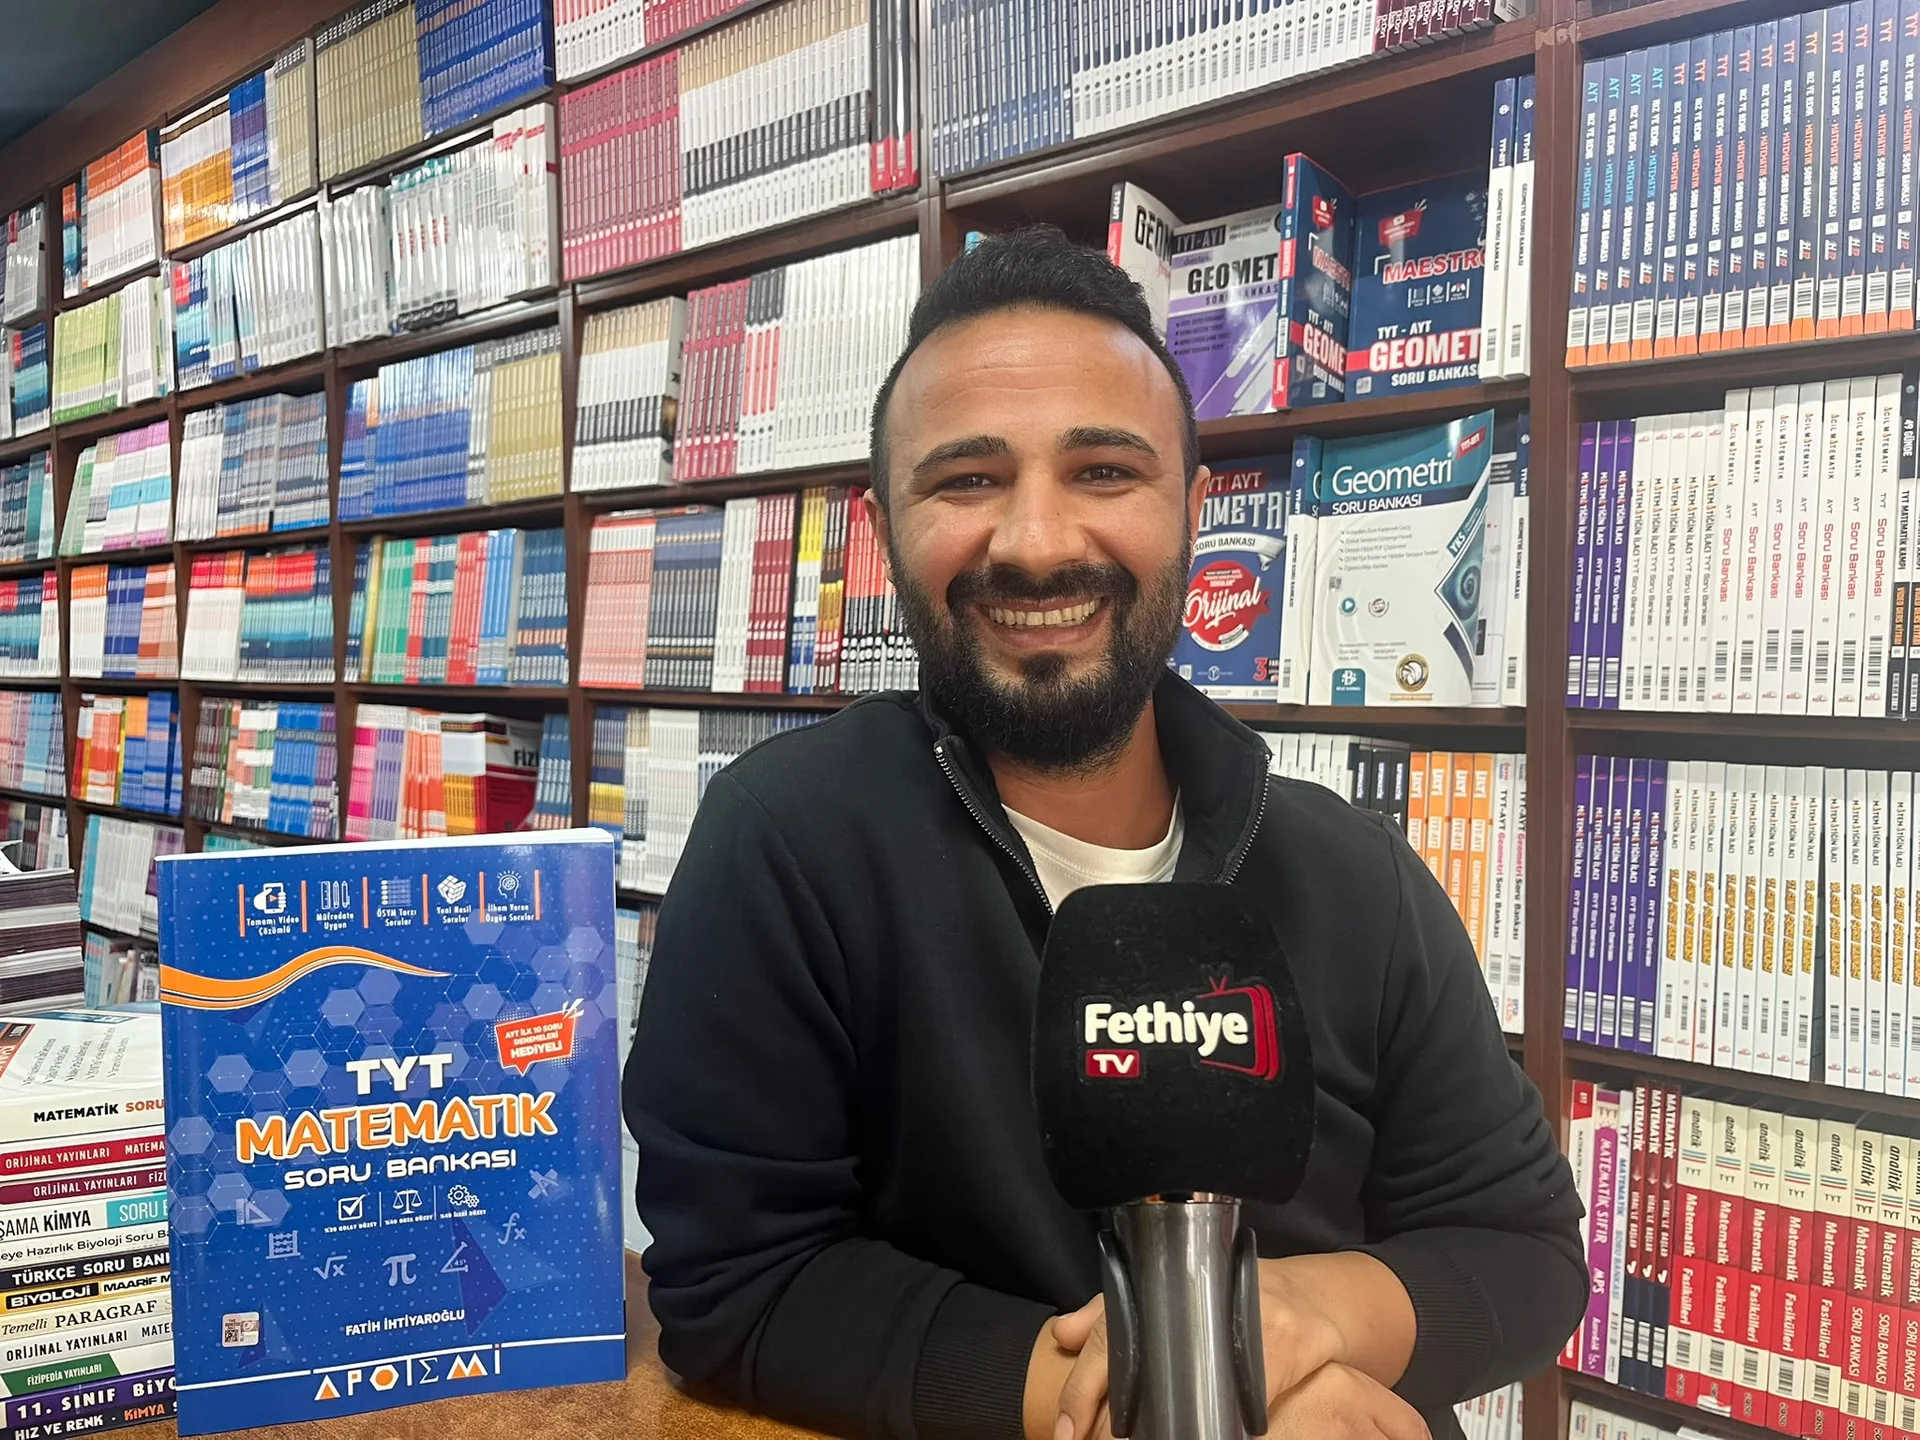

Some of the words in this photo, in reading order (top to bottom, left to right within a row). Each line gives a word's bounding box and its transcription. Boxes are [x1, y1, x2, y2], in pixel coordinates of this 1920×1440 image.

[1856, 24, 1868, 47] TYT
[1905, 12, 1919, 37] TYT
[1806, 32, 1818, 55] TYT
[1717, 55, 1728, 77] TYT
[1761, 45, 1772, 67] TYT
[1653, 68, 1663, 89] AYT
[1588, 82, 1598, 103] AYT
[1378, 325, 1398, 340] TYT
[1410, 320, 1432, 335] AYT
[1391, 371, 1425, 386] SORU
[1904, 419, 1914, 430] 49
[1231, 473, 1261, 490] AYT
[1332, 452, 1452, 496] Geometri
[1332, 500, 1366, 516] SORU
[1369, 494, 1422, 512] BANKASI
[1450, 531, 1466, 553] YKS
[1723, 528, 1732, 555] Soru
[1798, 521, 1808, 550] Soru
[1850, 521, 1860, 550] Soru
[1877, 518, 1887, 547] Soru
[1183, 576, 1261, 630] Orijinal
[1253, 657, 1268, 681] 3
[316, 912, 354, 921] Müfredata
[377, 908, 397, 917] ÖSYM
[399, 908, 417, 916] Tarzı
[436, 906, 452, 914] Yeni
[454, 905, 472, 913] Nesil
[485, 914, 507, 923] Özgün
[509, 913, 534, 921] Sorular
[488, 903, 507, 912] İlham
[510, 903, 529, 911] Veren
[247, 918, 276, 926] Tamamı
[279, 915, 299, 923] Video
[259, 926, 291, 937] Çözümlü
[324, 922, 347, 931] Uygun
[385, 918, 411, 926] Sorular
[505, 1030, 519, 1038] AYT
[543, 1023, 563, 1031] SORU
[513, 1031, 558, 1045] DENEMELERİ
[1085, 1001, 1248, 1057] Fethiye
[511, 1040, 563, 1058] HEDİYELİ
[346, 1053, 453, 1095] TYT
[1092, 1054, 1135, 1074] TV
[34, 1103, 119, 1122] MATEMATİK
[125, 1099, 165, 1112] SORU
[236, 1091, 558, 1165] MATEMATİK
[1620, 1124, 1630, 1147] TYT
[1725, 1116, 1736, 1155] analitik
[5, 1153, 53, 1169] ORİJİNAL
[56, 1148, 110, 1163] YAYINLARI
[1793, 1129, 1805, 1168] analitik
[1830, 1133, 1842, 1173] analitik
[284, 1162, 372, 1190] SORU
[386, 1150, 517, 1177] BANKASI
[1595, 1138, 1611, 1208] MATEMATİK
[1719, 1173, 1735, 1184] TYT
[1887, 1145, 1901, 1193] analitik
[34, 1182, 81, 1197] ORİJİNAL
[84, 1176, 137, 1190] YAYINLARI
[1788, 1188, 1805, 1198] TYT
[1825, 1193, 1841, 1203] TYT
[43, 1210, 91, 1232] KİMYA
[119, 1201, 158, 1222] SORU
[1594, 1210, 1610, 1244] SIFIR
[1883, 1210, 1900, 1221] TYT
[27, 1243, 74, 1257] Hazırlık
[78, 1235, 122, 1250] Biyoloji
[126, 1232, 153, 1243] Soru
[1717, 1200, 1732, 1265] Matematik
[1786, 1215, 1801, 1283] Matematik
[1821, 1220, 1837, 1288] Matematik
[12, 1265, 76, 1285] TÜRKÇE
[83, 1259, 125, 1276] SORU
[1880, 1231, 1897, 1298] Matematik
[1592, 1267, 1606, 1295] MPS
[1713, 1275, 1727, 1334] Fasikülleri
[2, 1318, 48, 1336] Temelli
[55, 1300, 157, 1328] PARAGRAF
[345, 1319, 381, 1336] FATİH
[384, 1309, 465, 1332] İHTİYAROĞLU
[1782, 1292, 1797, 1352] Fasikülleri
[1818, 1299, 1833, 1359] Fasikülleri
[1878, 1313, 1890, 1341] SORU
[7, 1342, 62, 1362] ORİJİNAL
[66, 1330, 128, 1350] YAYINLARI
[27, 1372, 63, 1386] FİZİPEDİA
[64, 1364, 102, 1379] YAYINLARI
[1876, 1342, 1888, 1384] BANKASI
[17, 1402, 52, 1419] 11.
[61, 1388, 116, 1411] SINIF
[15, 1427, 40, 1440] HIZ
[43, 1422, 62, 1435] VE
[66, 1414, 103, 1432] RENK
[124, 1404, 165, 1421] KİMYA
